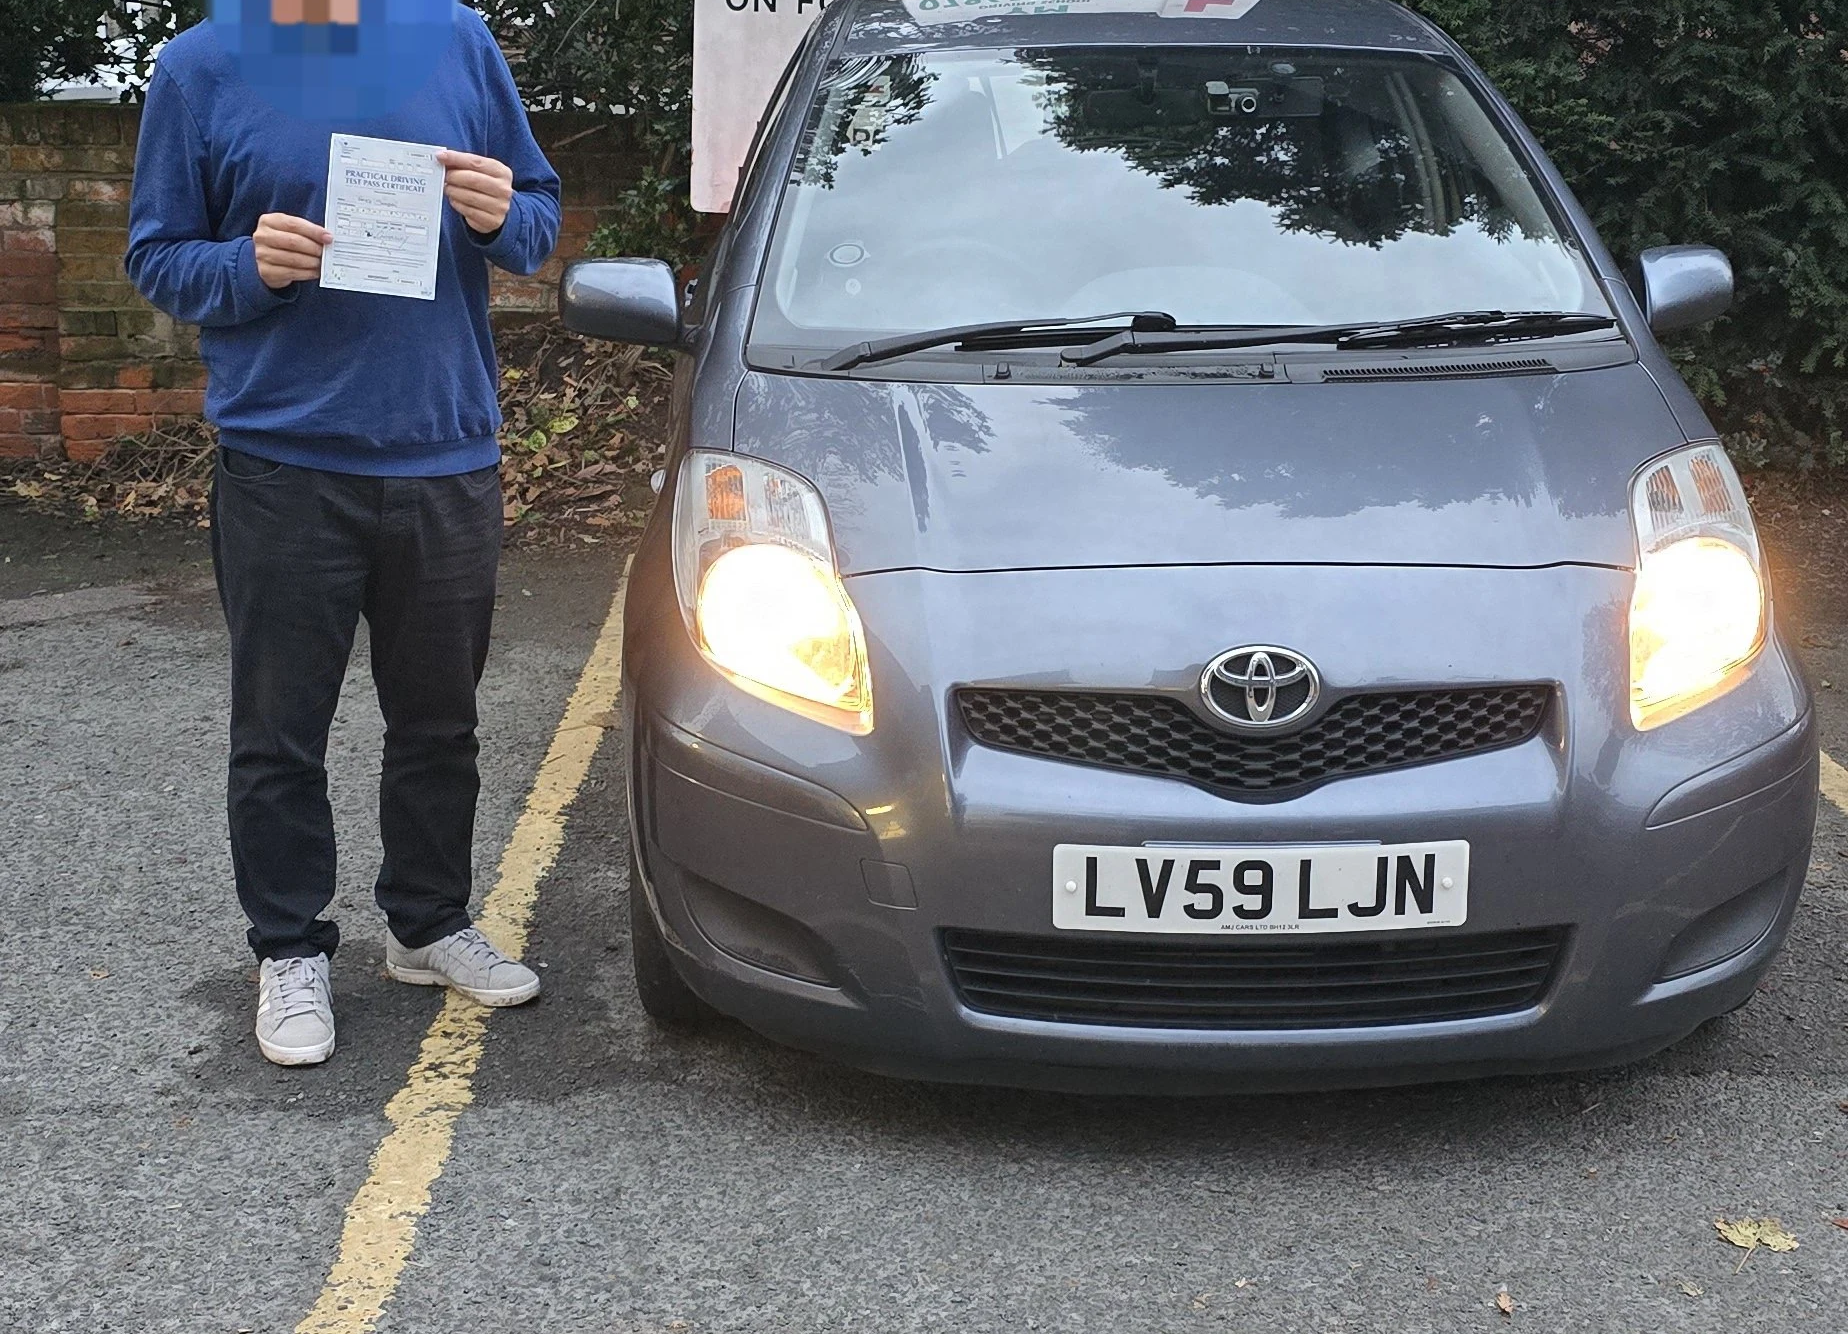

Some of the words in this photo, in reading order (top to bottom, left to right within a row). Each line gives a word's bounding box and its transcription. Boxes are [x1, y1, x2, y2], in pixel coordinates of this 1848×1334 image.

[346, 170, 388, 181] PRACTICAL
[391, 175, 426, 186] DRIVING
[346, 177, 361, 185] TEST
[382, 182, 425, 193] CERTIFICATE
[1085, 856, 1274, 921] LV59
[1298, 853, 1436, 920] LJN
